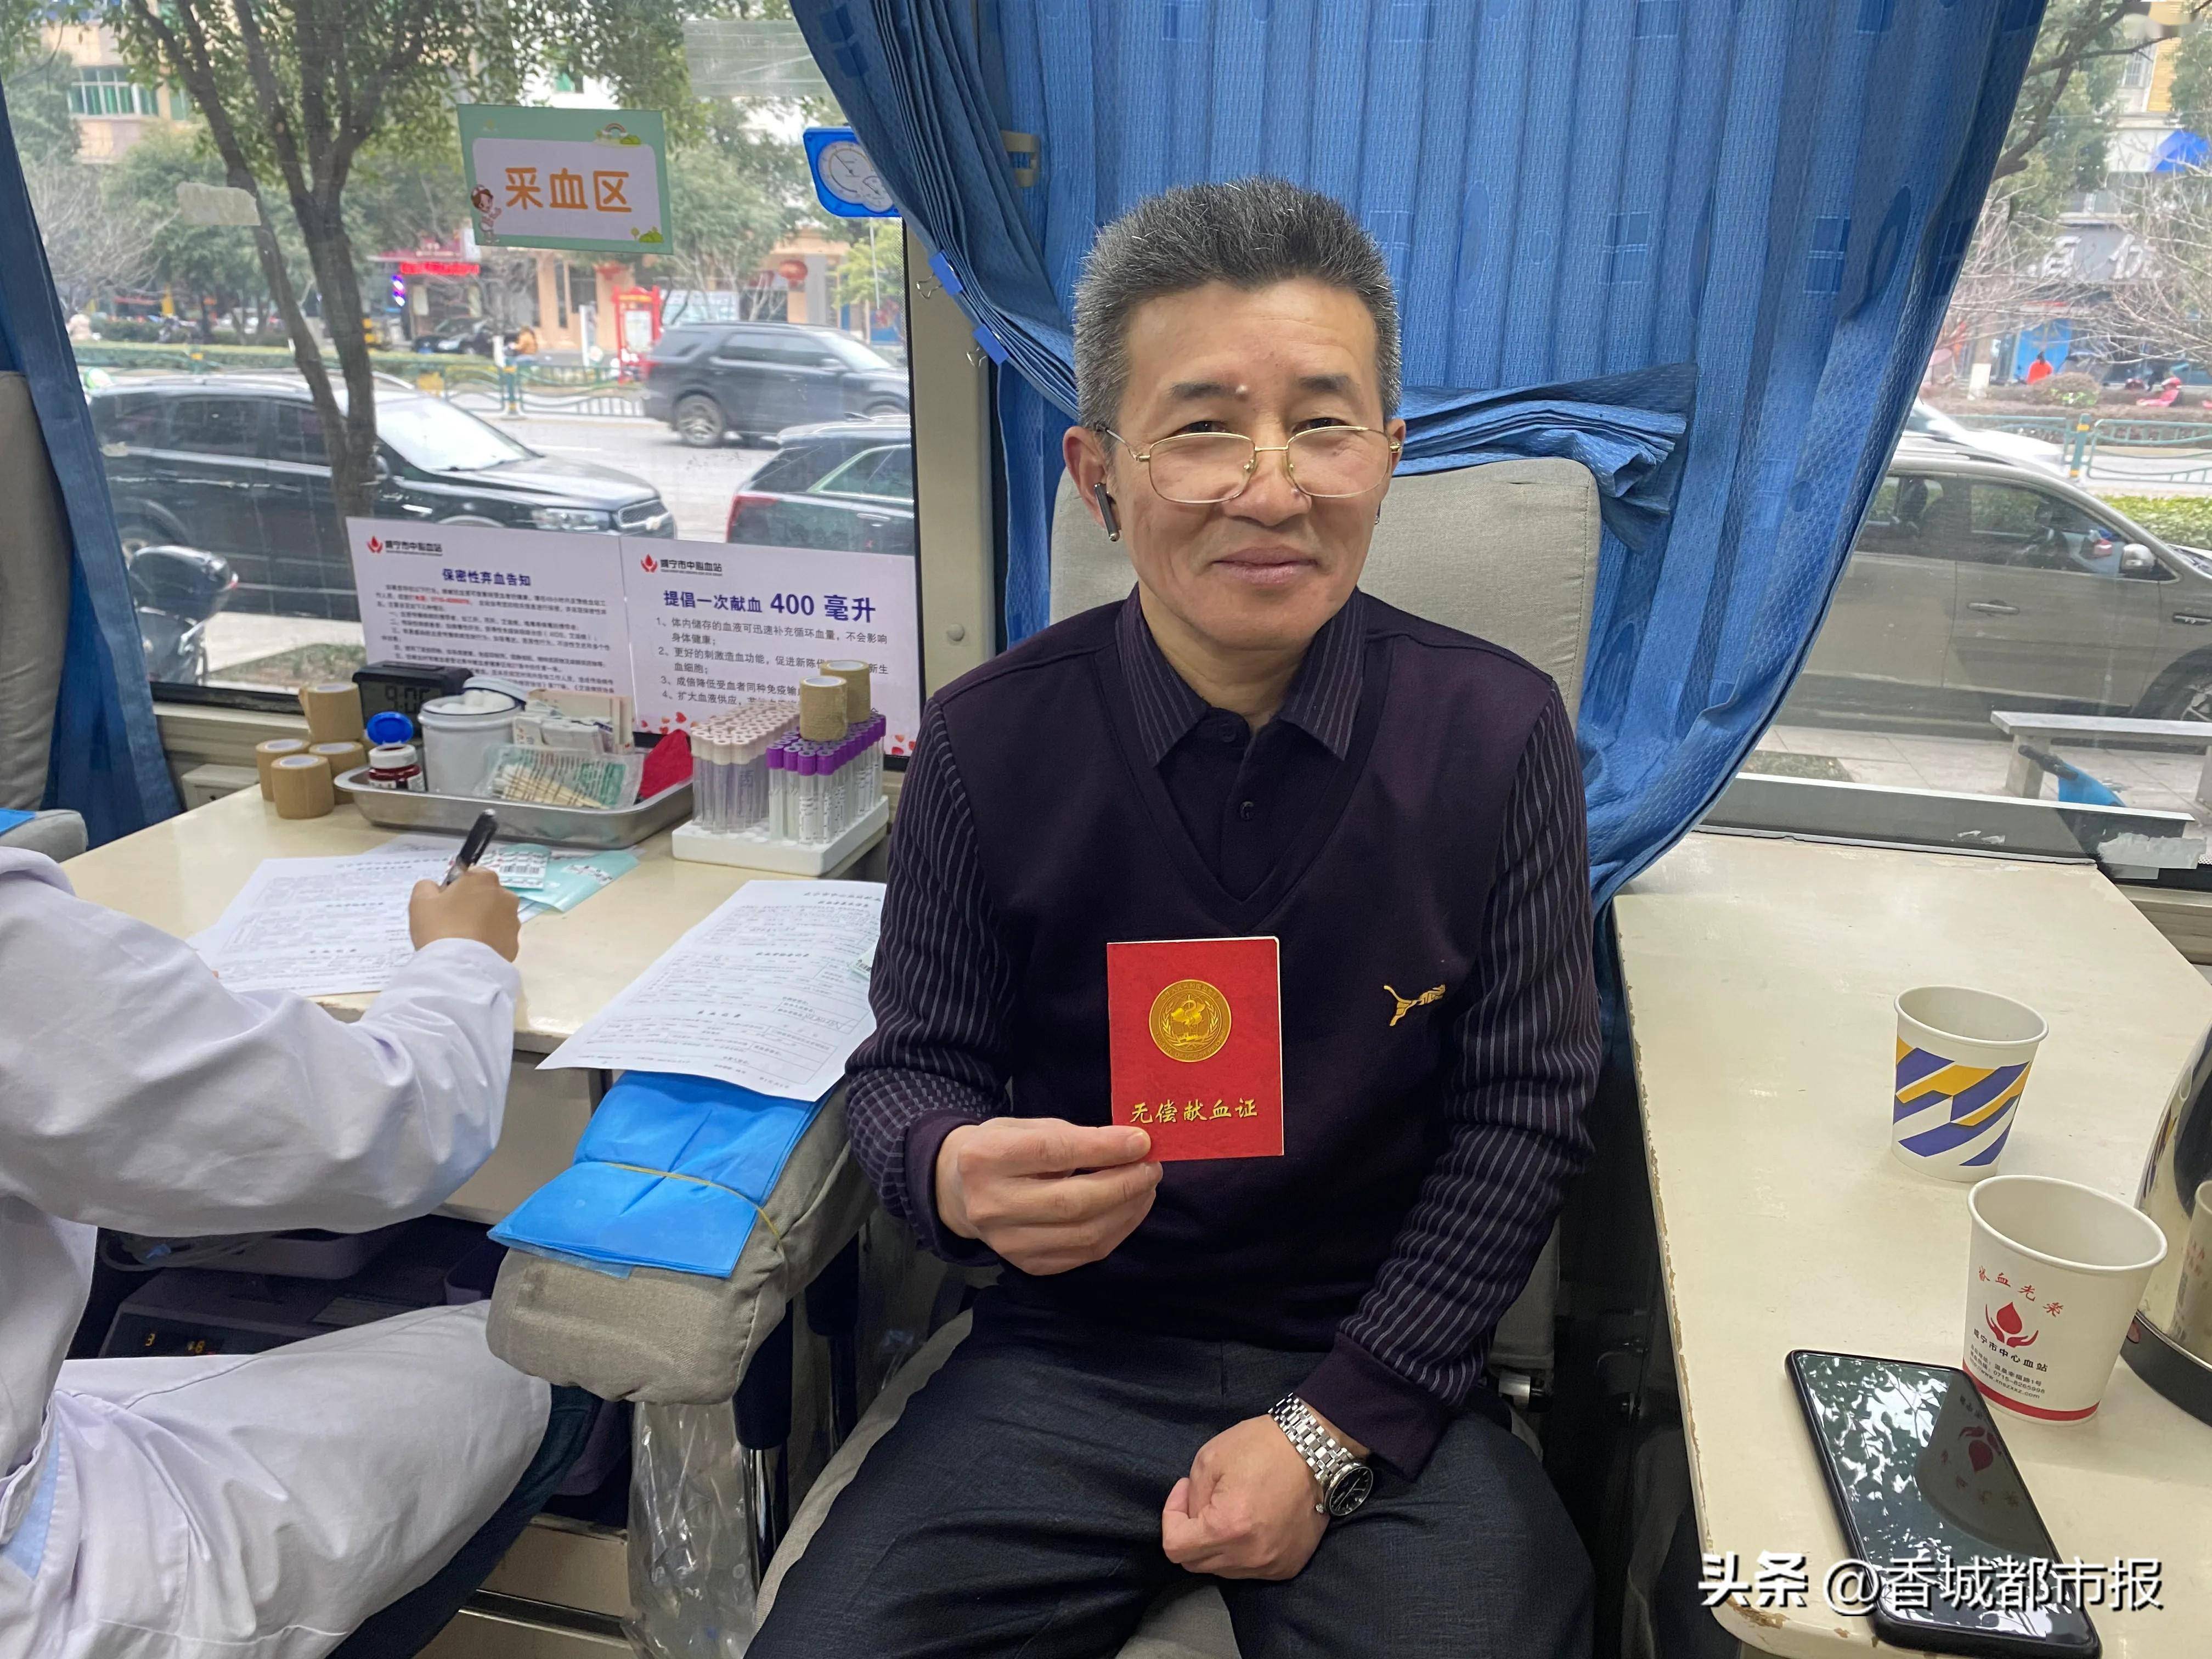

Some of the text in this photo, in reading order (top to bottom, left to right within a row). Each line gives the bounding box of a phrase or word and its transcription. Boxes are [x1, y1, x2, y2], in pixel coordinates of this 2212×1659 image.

[505, 167, 632, 212] 采血区
[442, 568, 531, 586] 保密性弃血告知
[663, 590, 876, 623] 提倡一次献血 400 毫升
[1130, 1097, 1258, 1124] 无偿献血证
